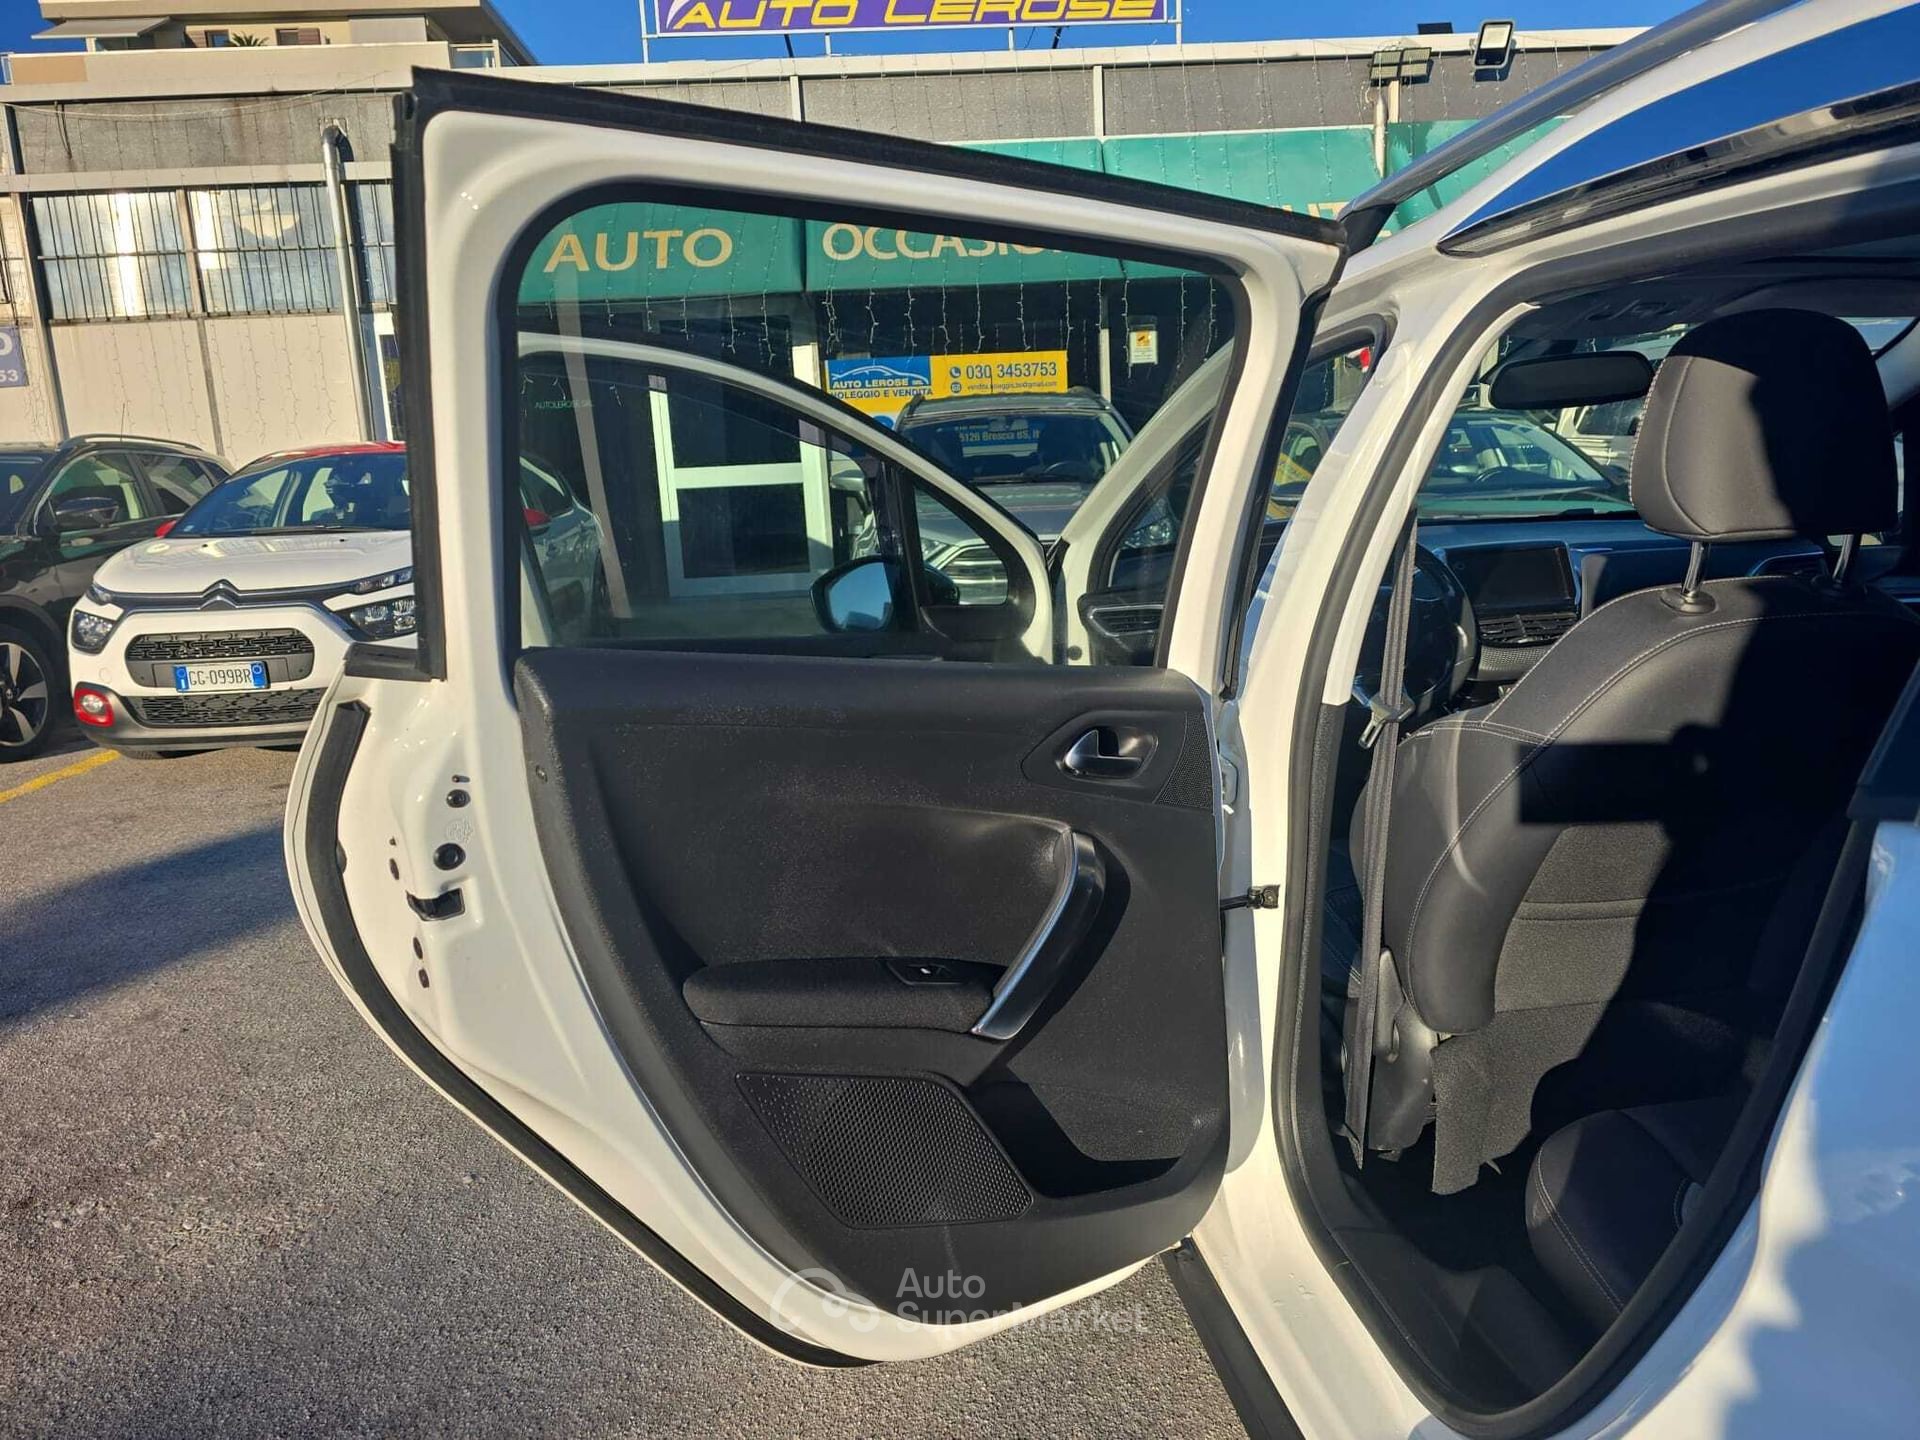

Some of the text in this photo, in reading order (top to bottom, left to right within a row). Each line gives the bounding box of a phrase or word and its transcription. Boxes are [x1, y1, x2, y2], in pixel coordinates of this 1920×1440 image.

[672, 0, 1154, 29] AUTO LEROSE
[543, 228, 733, 273] AUTO
[966, 361, 1057, 380] 030 3453753
[832, 380, 862, 389] AUTO
[865, 377, 909, 388] LEROSE
[884, 389, 890, 398] E
[892, 387, 933, 397] VENDITA
